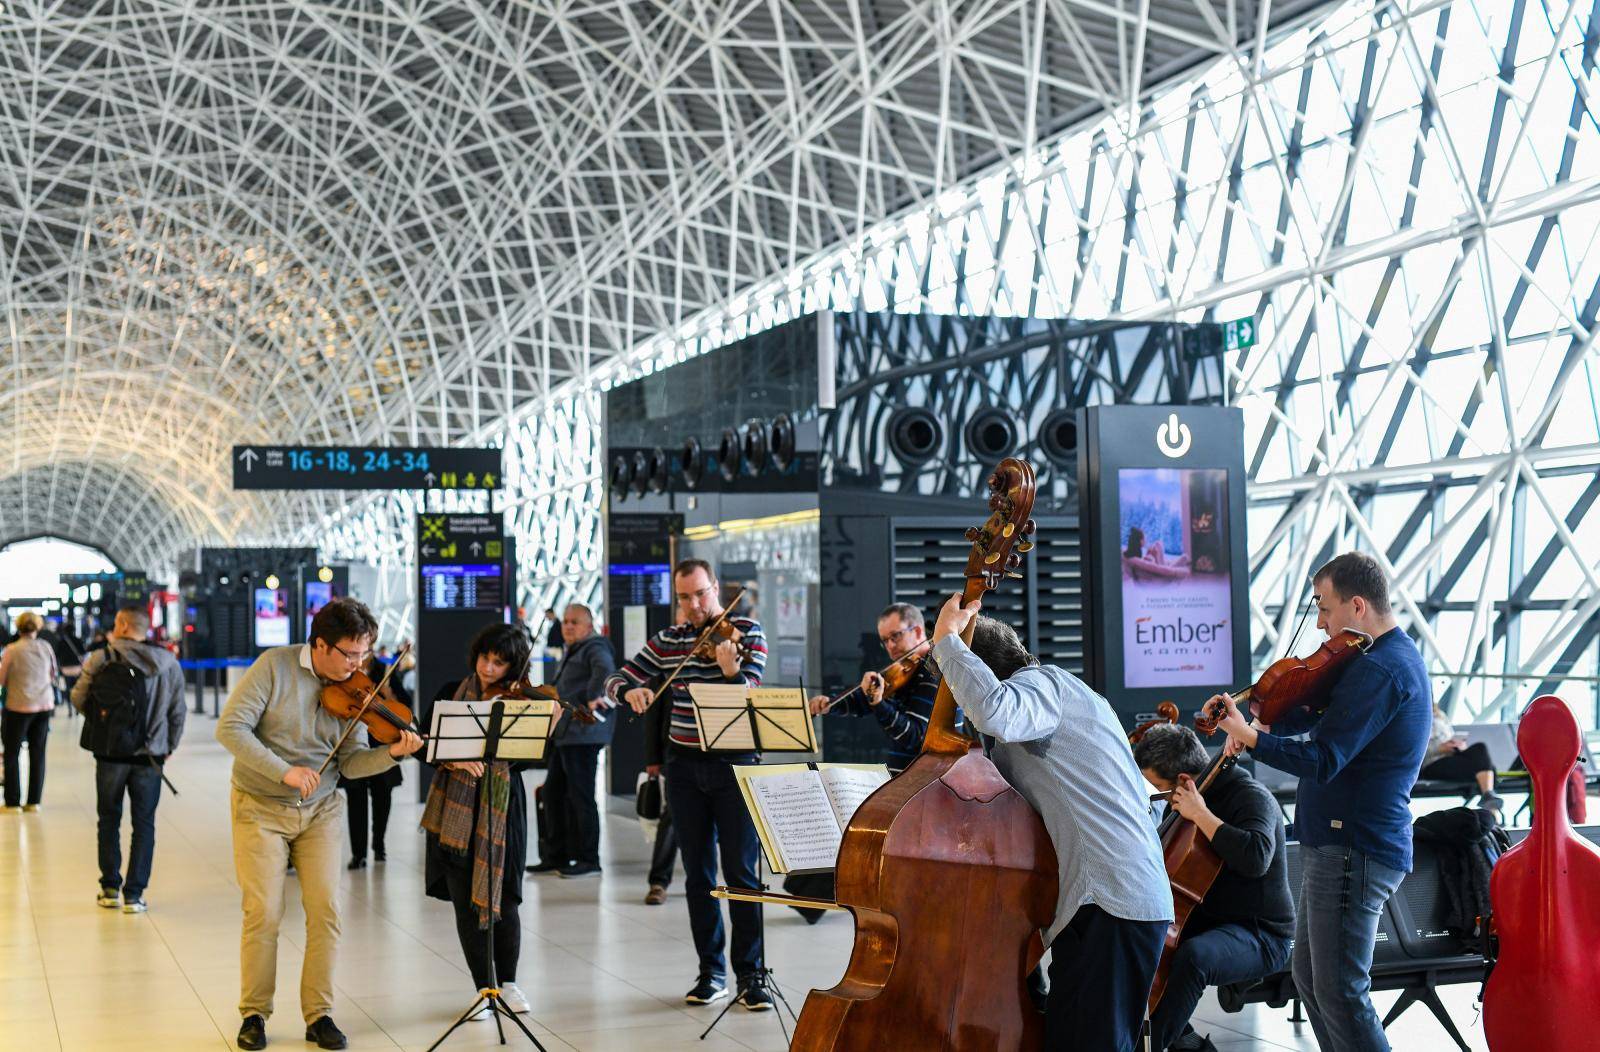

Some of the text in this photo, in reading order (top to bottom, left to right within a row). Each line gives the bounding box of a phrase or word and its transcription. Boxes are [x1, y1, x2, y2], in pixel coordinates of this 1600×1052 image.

[288, 450, 429, 474] 16-18, 24-34
[1136, 617, 1226, 644] Ember
